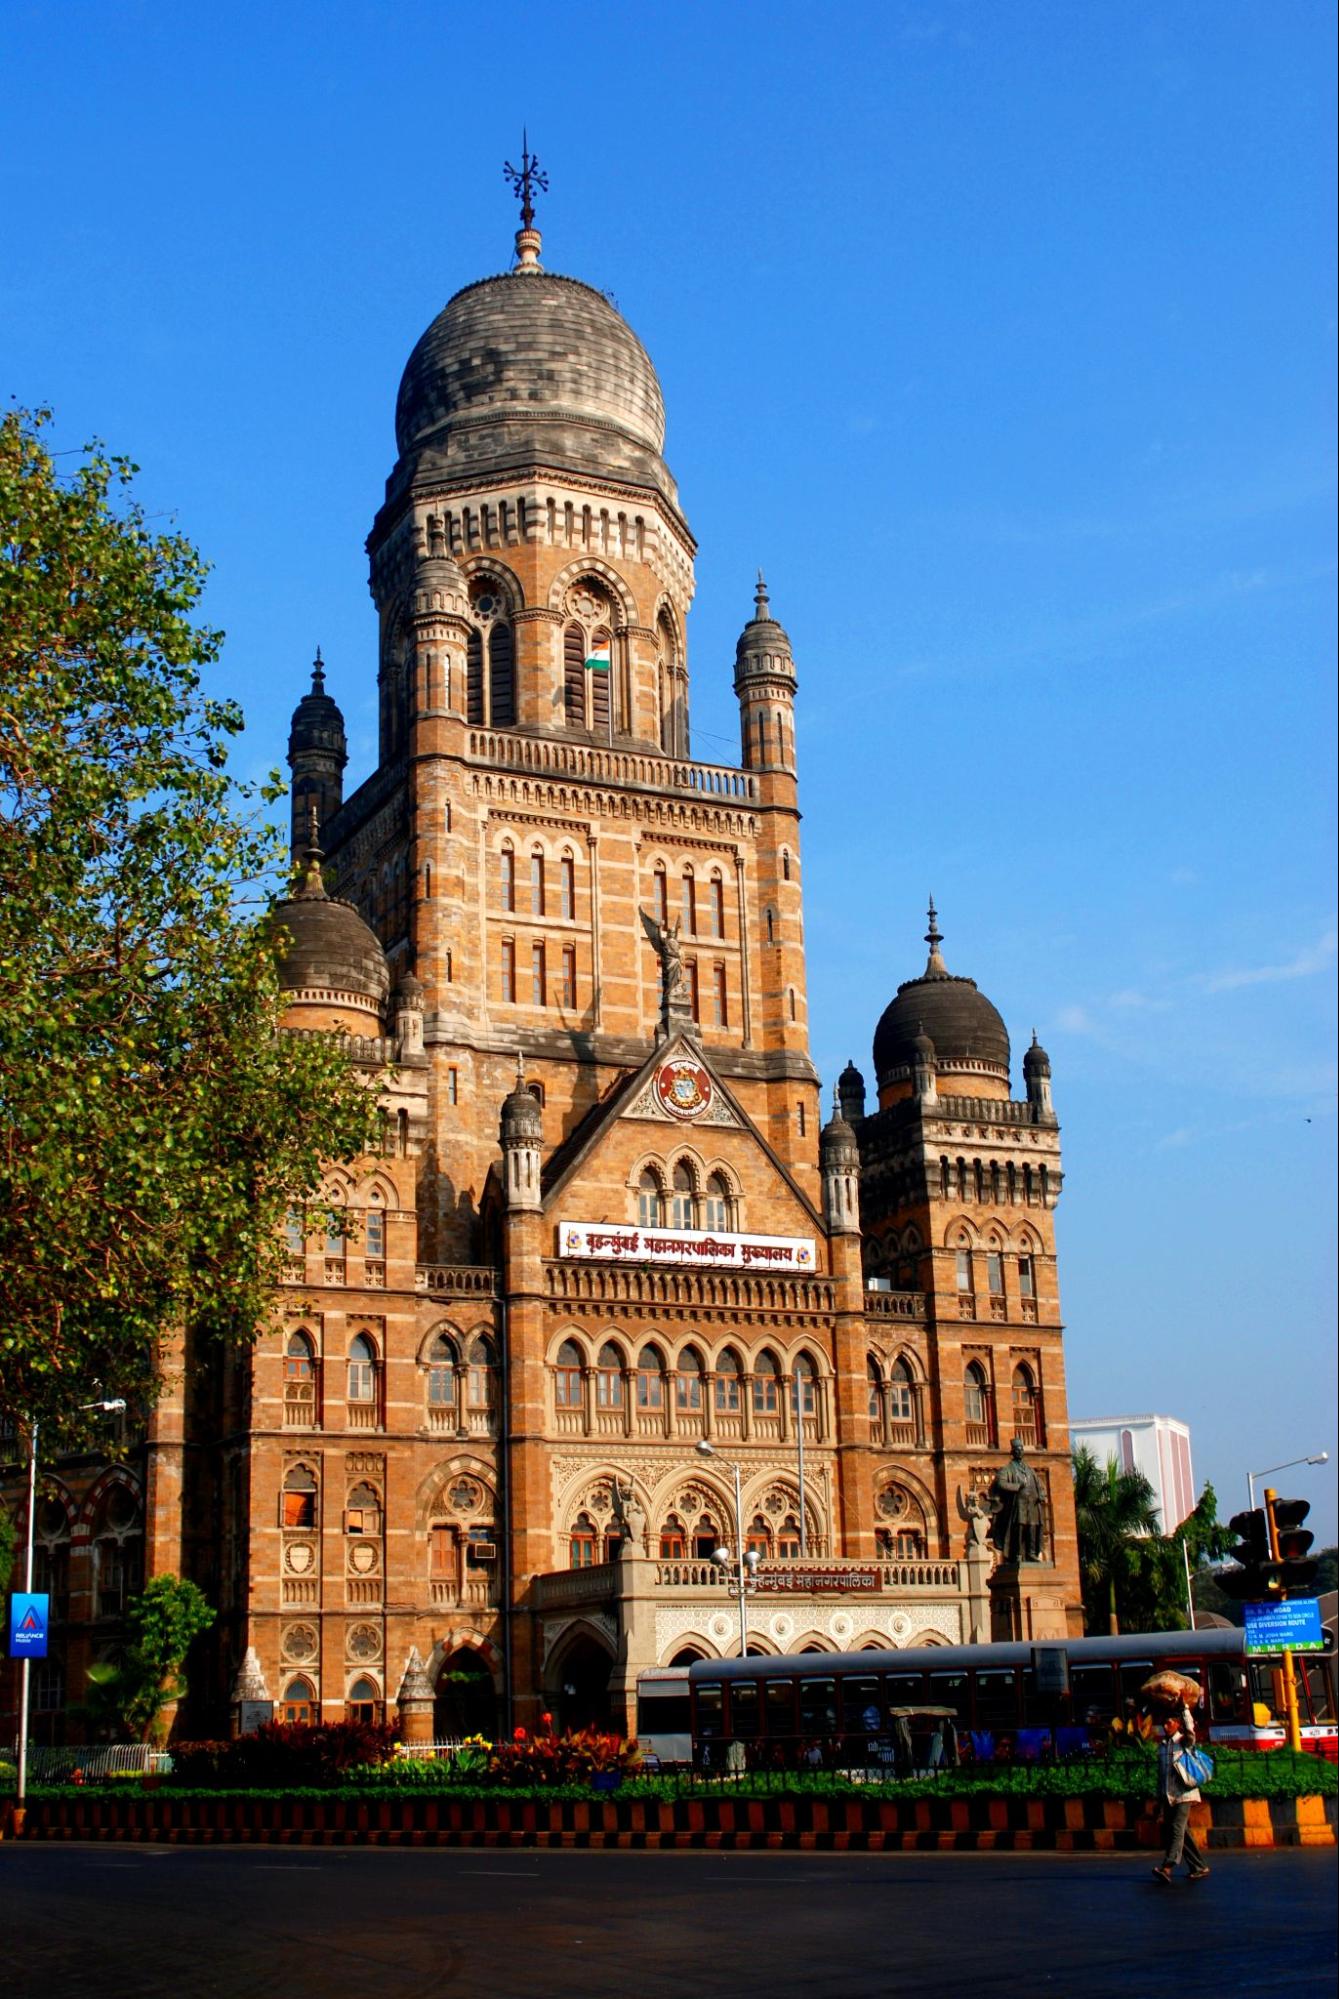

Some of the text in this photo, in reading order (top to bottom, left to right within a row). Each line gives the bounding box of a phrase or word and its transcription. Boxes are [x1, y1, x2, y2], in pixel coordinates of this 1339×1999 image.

[586, 1232, 793, 1264] बृहन्मुंबई महानगरपालिका मुख्यालय
[1258, 1620, 1288, 1628] DIVERSION
